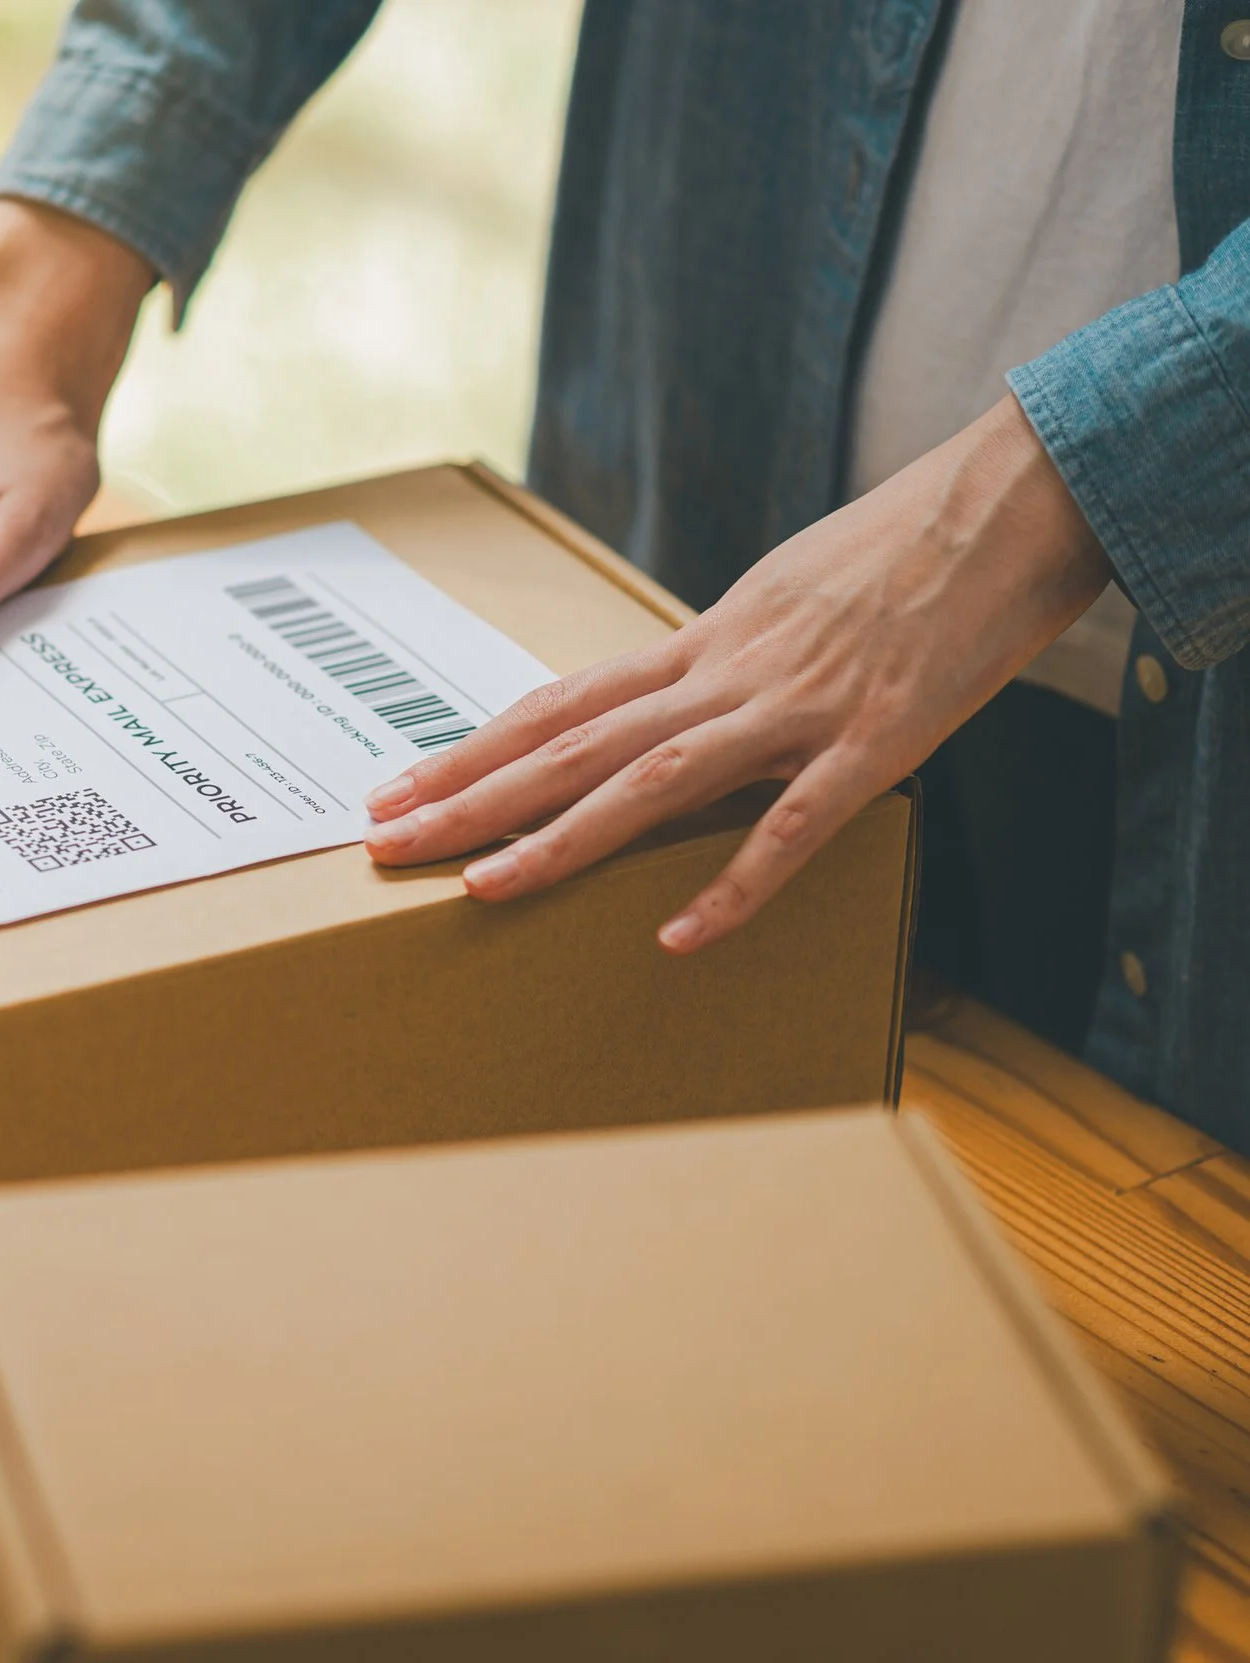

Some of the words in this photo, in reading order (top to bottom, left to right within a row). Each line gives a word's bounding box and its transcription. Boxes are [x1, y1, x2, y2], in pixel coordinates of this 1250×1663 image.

[19, 633, 114, 704] EXPRESS
[107, 704, 164, 746] MAIL
[334, 716, 384, 758] Tracking
[34, 734, 56, 751] Zip
[33, 758, 58, 780] City,
[52, 750, 83, 774] State
[246, 753, 285, 784] 123-456-7
[151, 751, 257, 823] PRIORITY
[299, 793, 326, 814] Order
